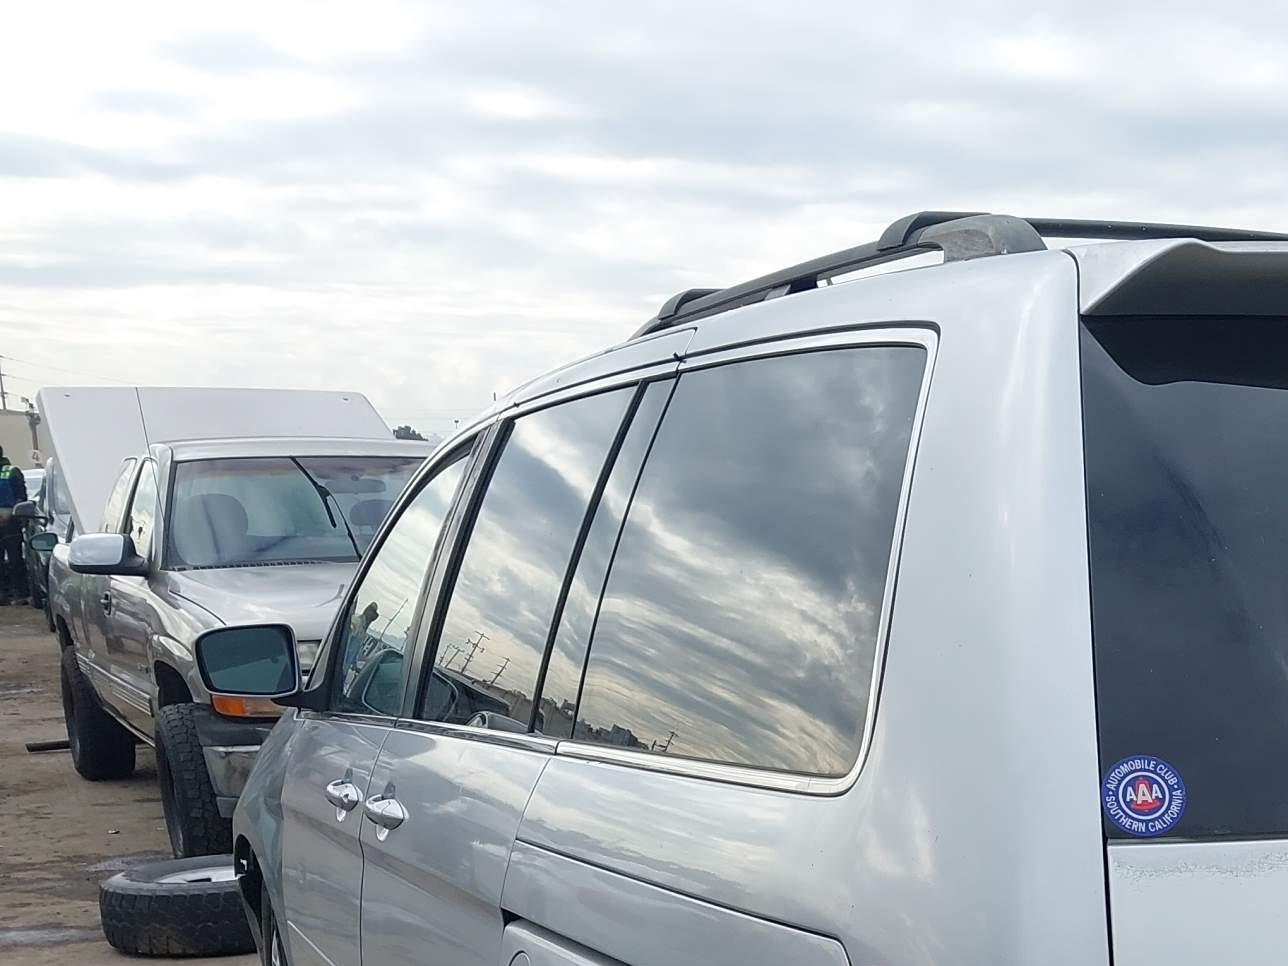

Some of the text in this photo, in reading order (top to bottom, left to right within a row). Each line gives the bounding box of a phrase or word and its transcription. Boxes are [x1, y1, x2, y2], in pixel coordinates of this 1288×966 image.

[1106, 759, 1178, 791] AUTOMOBILE CLUB
[1126, 783, 1163, 805] AAA
[1105, 789, 1183, 833] SOUTHERN CALIFORNIA
